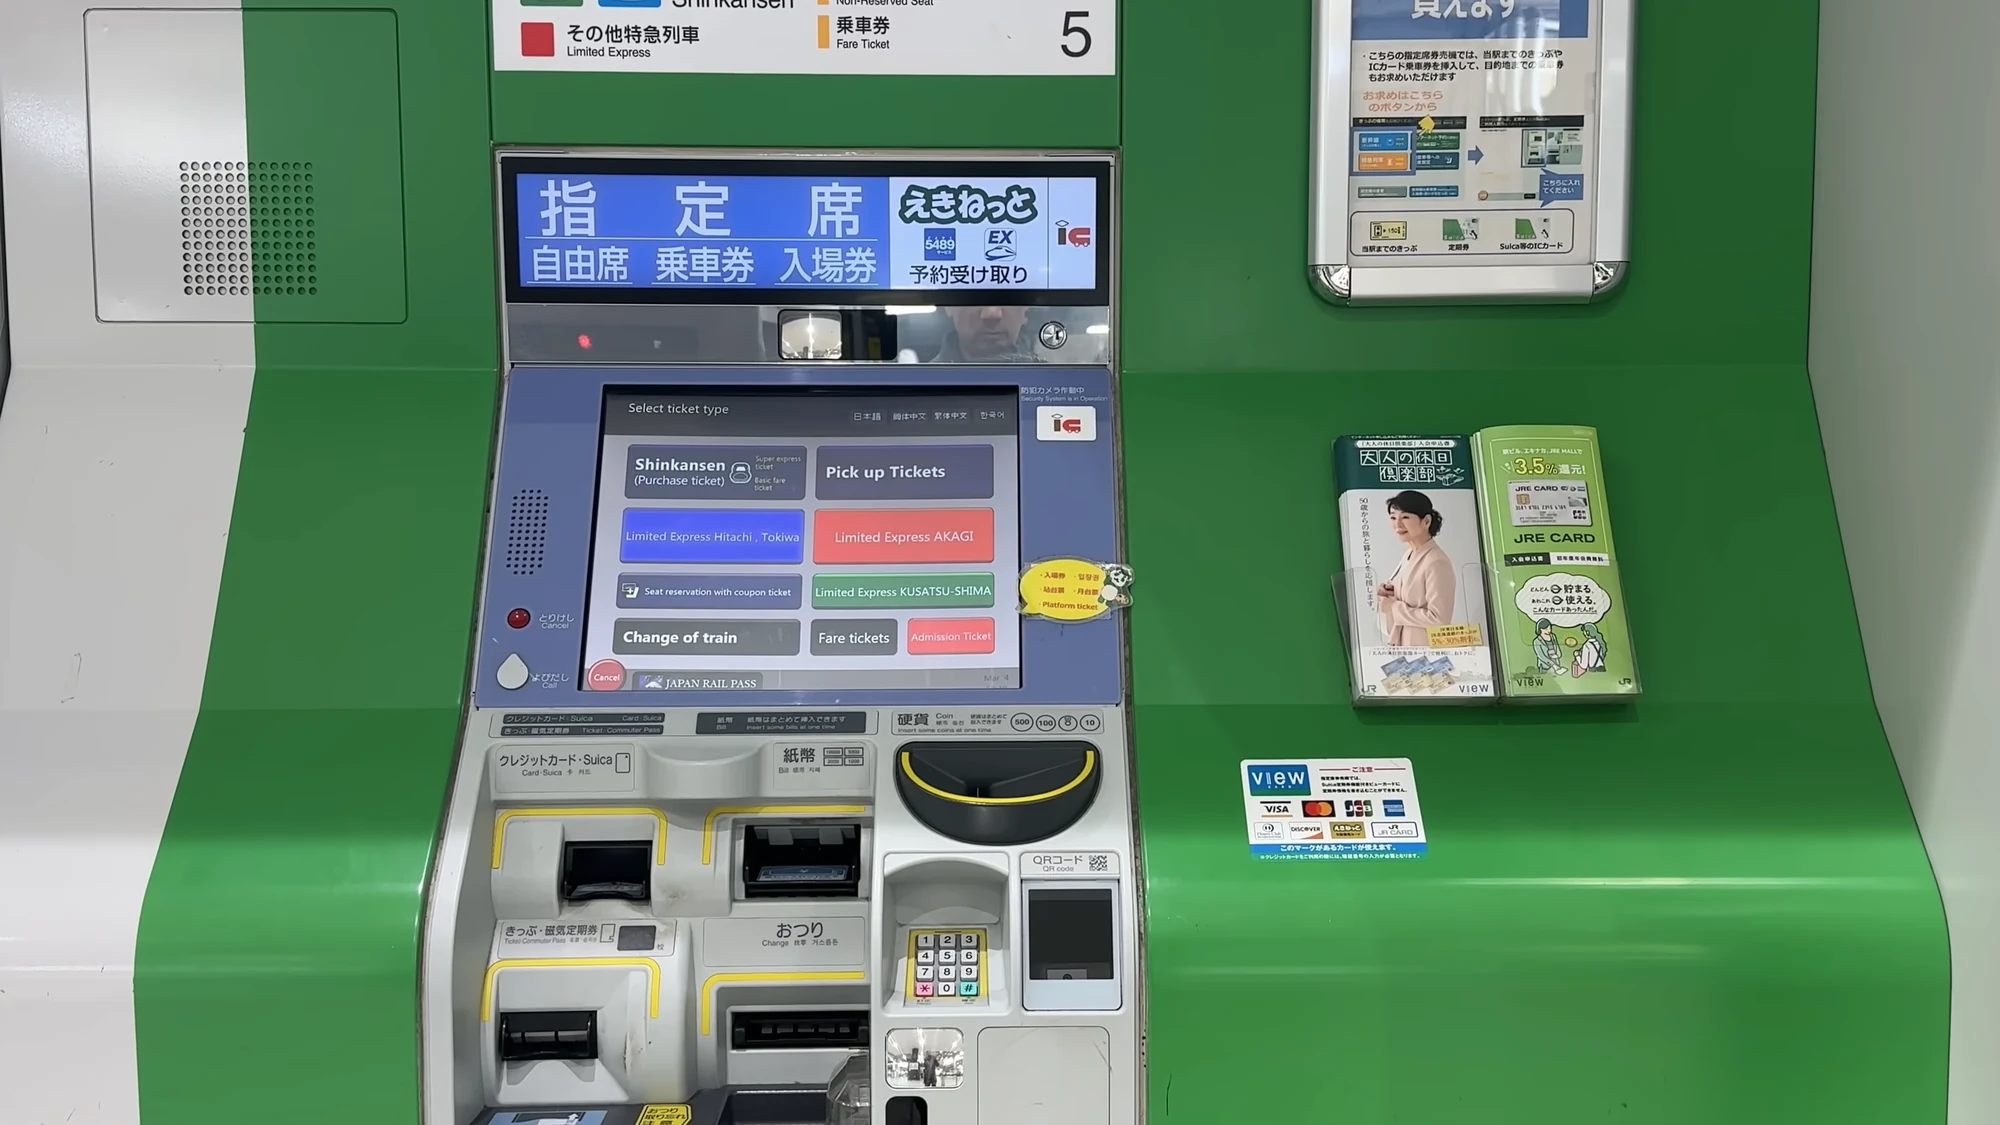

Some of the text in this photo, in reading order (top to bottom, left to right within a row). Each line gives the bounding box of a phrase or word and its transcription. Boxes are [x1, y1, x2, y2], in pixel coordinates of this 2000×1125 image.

[836, 16, 890, 35] 乗車券
[567, 24, 700, 44] その他特急列車
[1060, 11, 1092, 58] 5
[837, 39, 890, 49] Fare Ticket
[567, 46, 651, 59] Limited Express
[1368, 61, 1564, 71] ICカード乗車券を挿入して、目的地までの券
[1368, 72, 1456, 82] もお求めいただけます
[1362, 91, 1443, 100] お求めはこちら
[1368, 102, 1437, 112] のボタンから
[902, 187, 1035, 222] えきねっと
[988, 230, 1013, 244] EX
[925, 239, 955, 250] 5489
[1448, 243, 1470, 251] 定期券
[1500, 242, 1563, 250] Suica等のICカード
[532, 246, 877, 283] 自由席 乗車券 入場券
[909, 265, 1028, 284] 予約受け取り
[628, 403, 729, 416] Select ticket type
[755, 456, 801, 464] Super express
[1360, 449, 1452, 466] 大人の休日
[635, 458, 726, 471] Shinkansen
[826, 465, 946, 482] Pick up Tickets
[1379, 465, 1435, 483] 倶楽部
[634, 475, 725, 487] (Purchase ticket)
[626, 531, 800, 544] Limited Express Hitachi Tokiwa
[834, 531, 974, 546] Limited Express AKAGI
[1514, 533, 1596, 544] JRE CARD
[644, 588, 791, 598] Seat reservation with coupon ticket
[815, 586, 992, 600] Limited Express KUSATSU-SHIMA
[1043, 601, 1076, 609] Platform
[539, 613, 575, 622] とりけし
[623, 630, 738, 645] Change of train
[818, 632, 890, 644] Fare tickets
[911, 631, 991, 642] Admission Ticket
[532, 673, 570, 682] よびだし
[594, 673, 620, 681] Cancel
[664, 678, 757, 689] JAPAN RAIL PASS
[897, 713, 930, 726] 硬貨
[500, 753, 613, 767] クレジットカード・Suica
[783, 747, 816, 763] 紙幣
[1265, 805, 1289, 813] VISA
[1345, 803, 1373, 814] JCB
[1033, 855, 1083, 865] QRコード
[505, 924, 598, 937] きっぷ・磁気定期券
[777, 922, 823, 938] おつり
[762, 939, 789, 947] Change
[922, 967, 973, 976] 7 8 9
